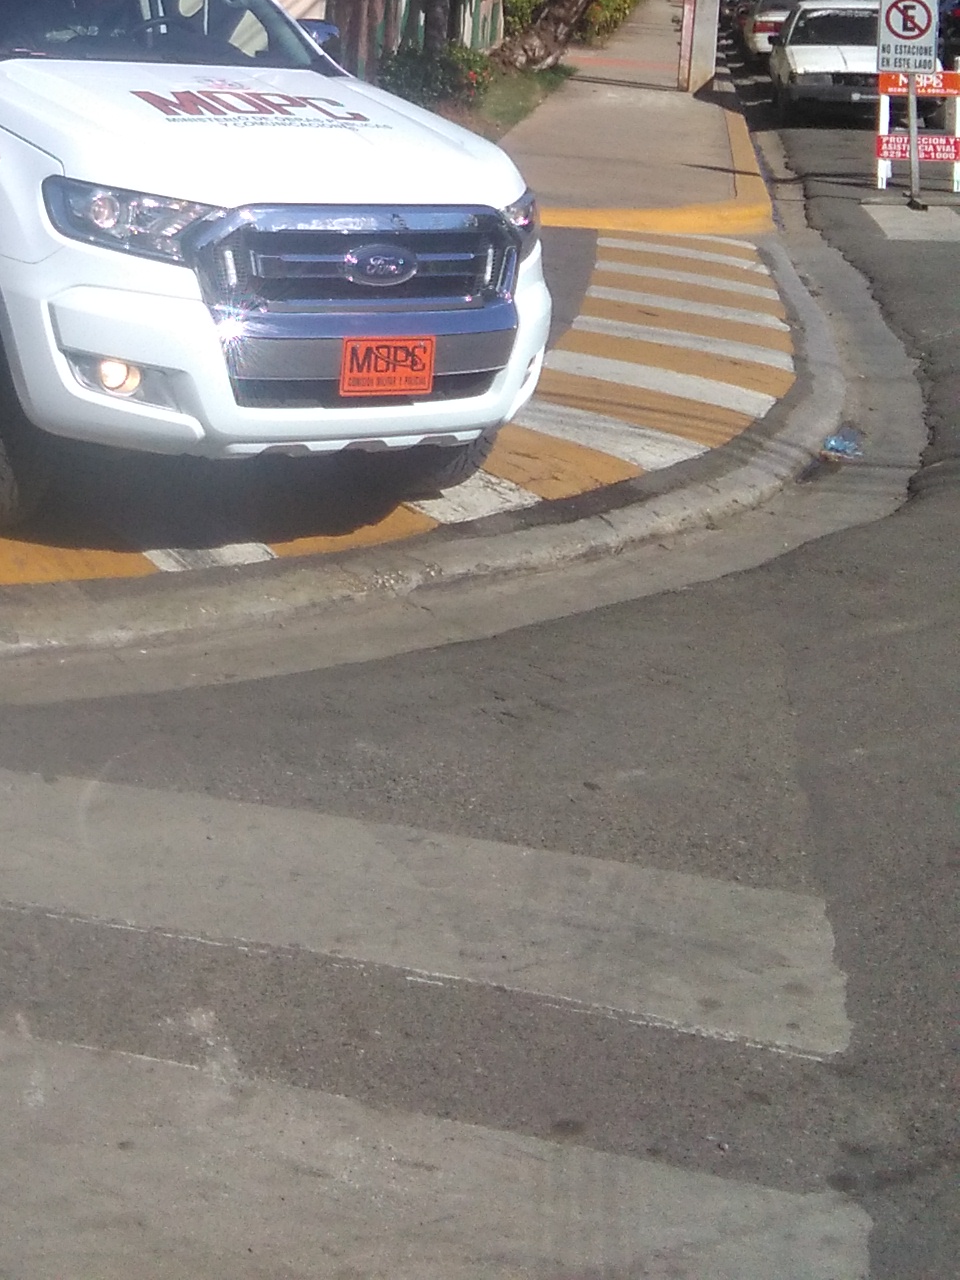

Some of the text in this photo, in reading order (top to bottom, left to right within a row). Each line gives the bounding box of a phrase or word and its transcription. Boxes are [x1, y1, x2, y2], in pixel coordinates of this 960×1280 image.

[881, 43, 933, 56] NO ESTACIONE
[881, 57, 933, 70] EN ESTE LADO
[130, 90, 370, 122] MOPC
[349, 345, 427, 373] MOPC
